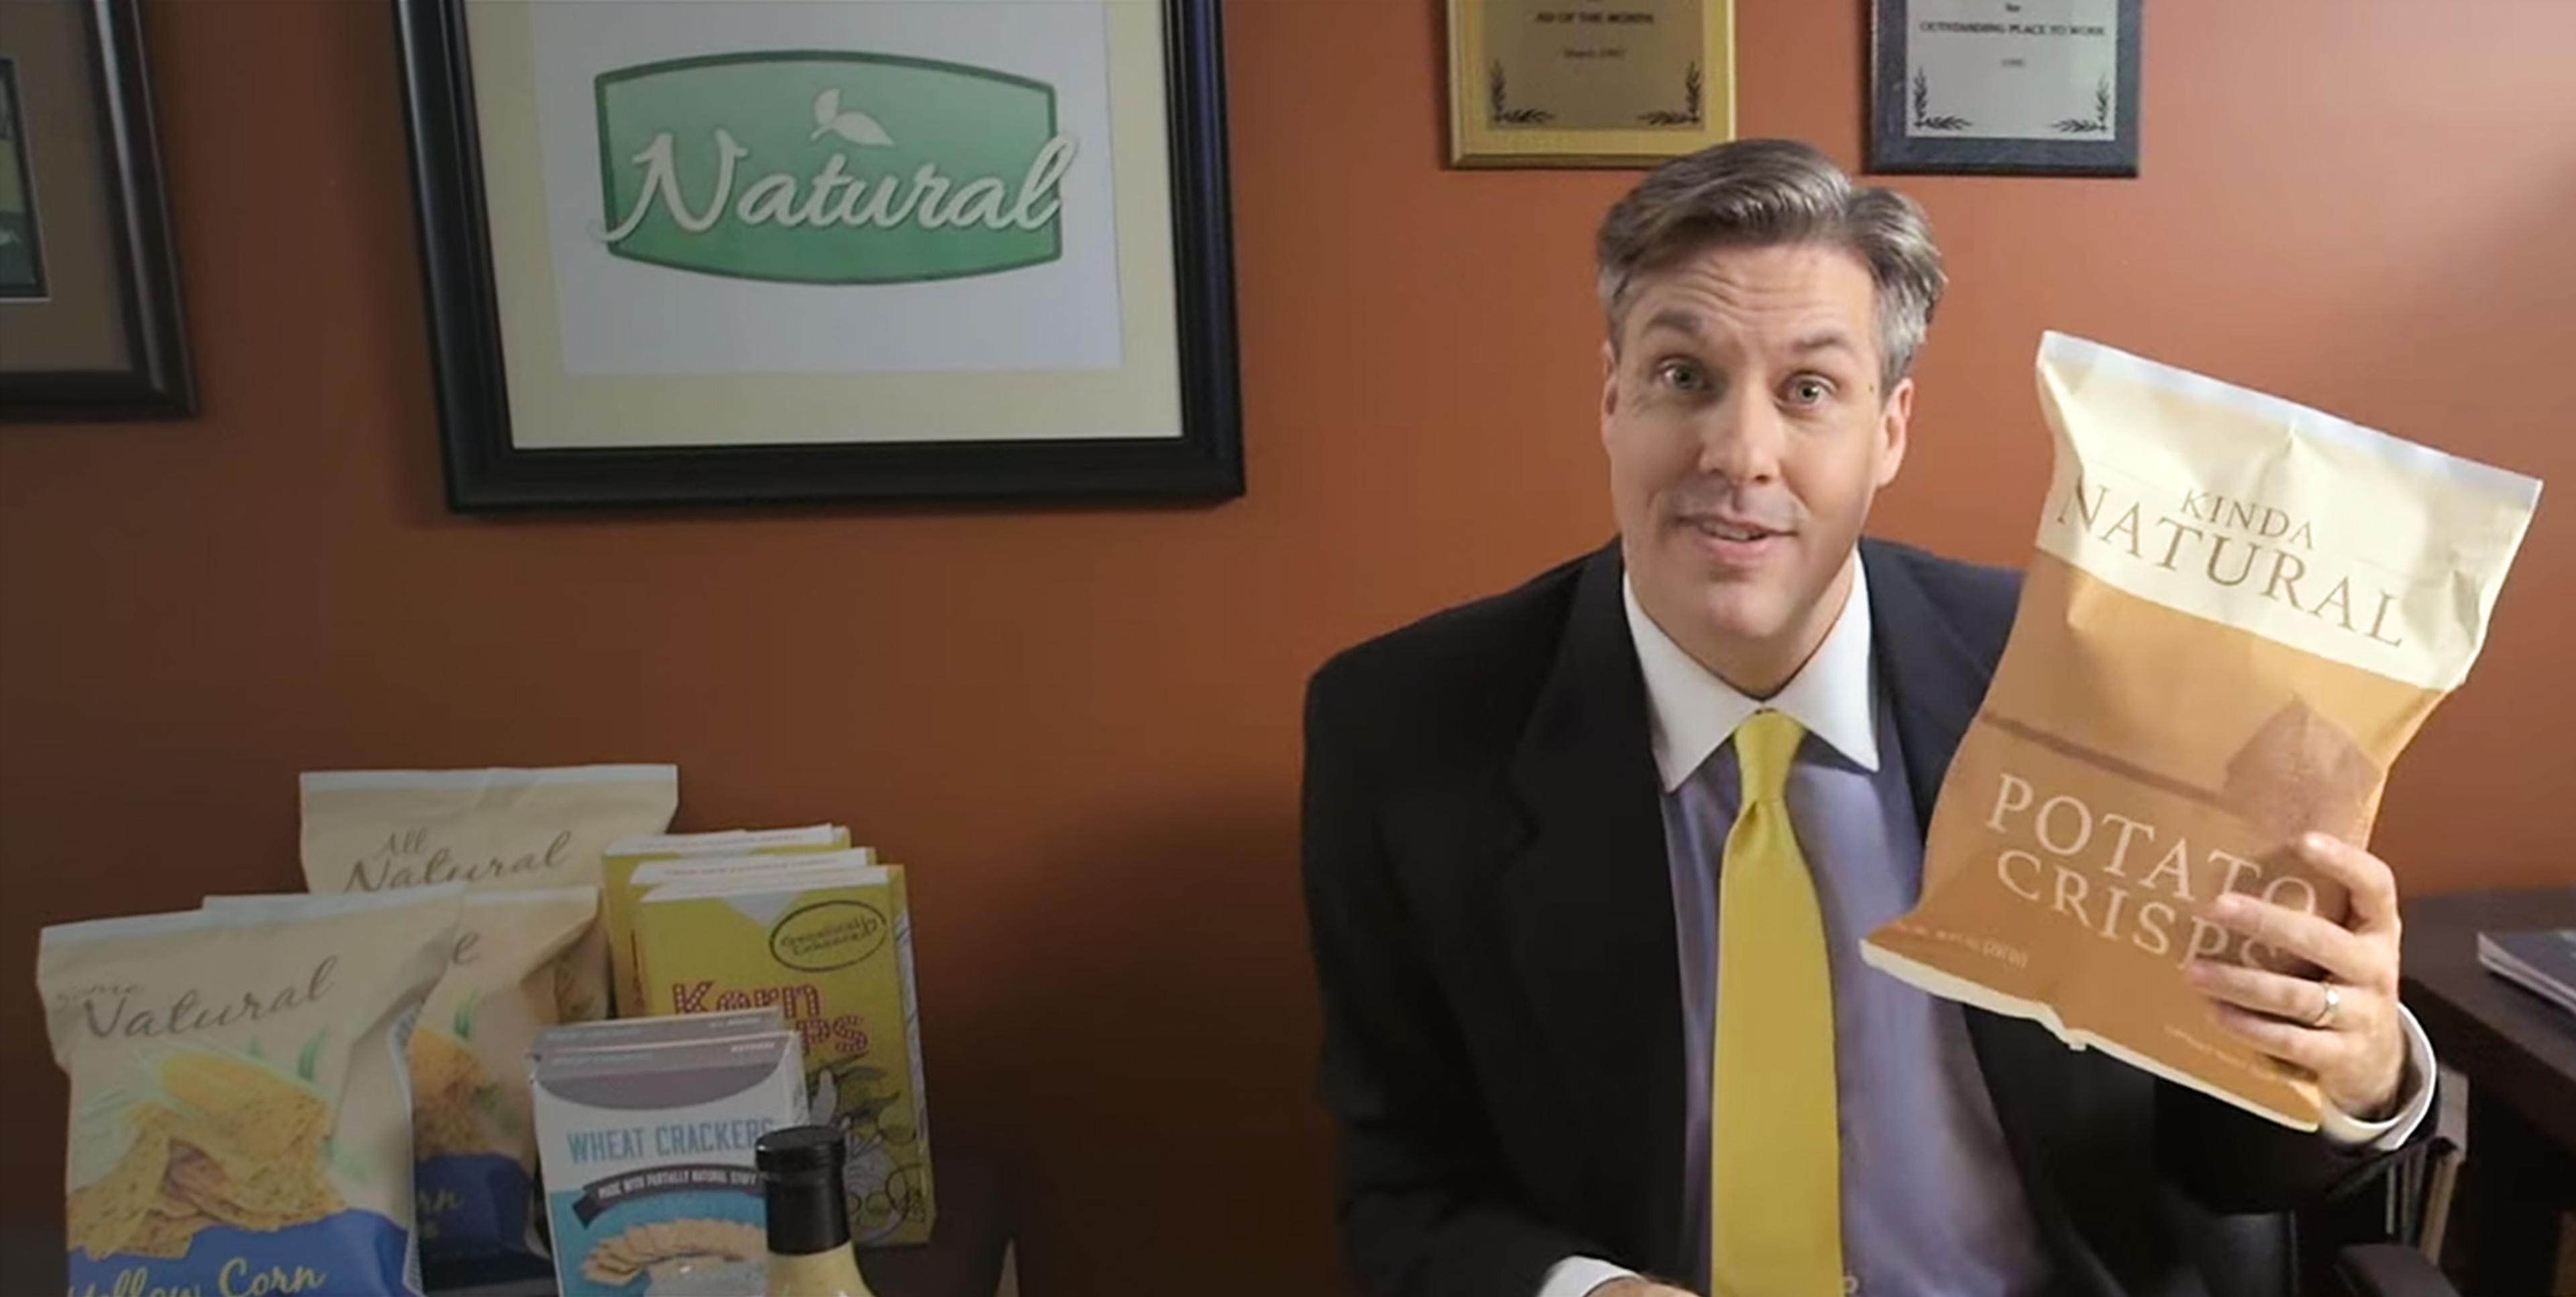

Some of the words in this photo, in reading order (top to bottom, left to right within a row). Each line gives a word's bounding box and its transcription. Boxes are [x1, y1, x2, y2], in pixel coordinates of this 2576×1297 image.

[2008, 23, 2045, 35] PLACE
[588, 129, 1079, 243] Natural
[2181, 488, 2314, 550] KINDA
[2057, 483, 2403, 648] NATURAL
[343, 830, 572, 893] Natural
[83, 954, 339, 1039] Natural
[567, 1127, 645, 1164] WHEAT
[218, 1256, 327, 1297] Corn
